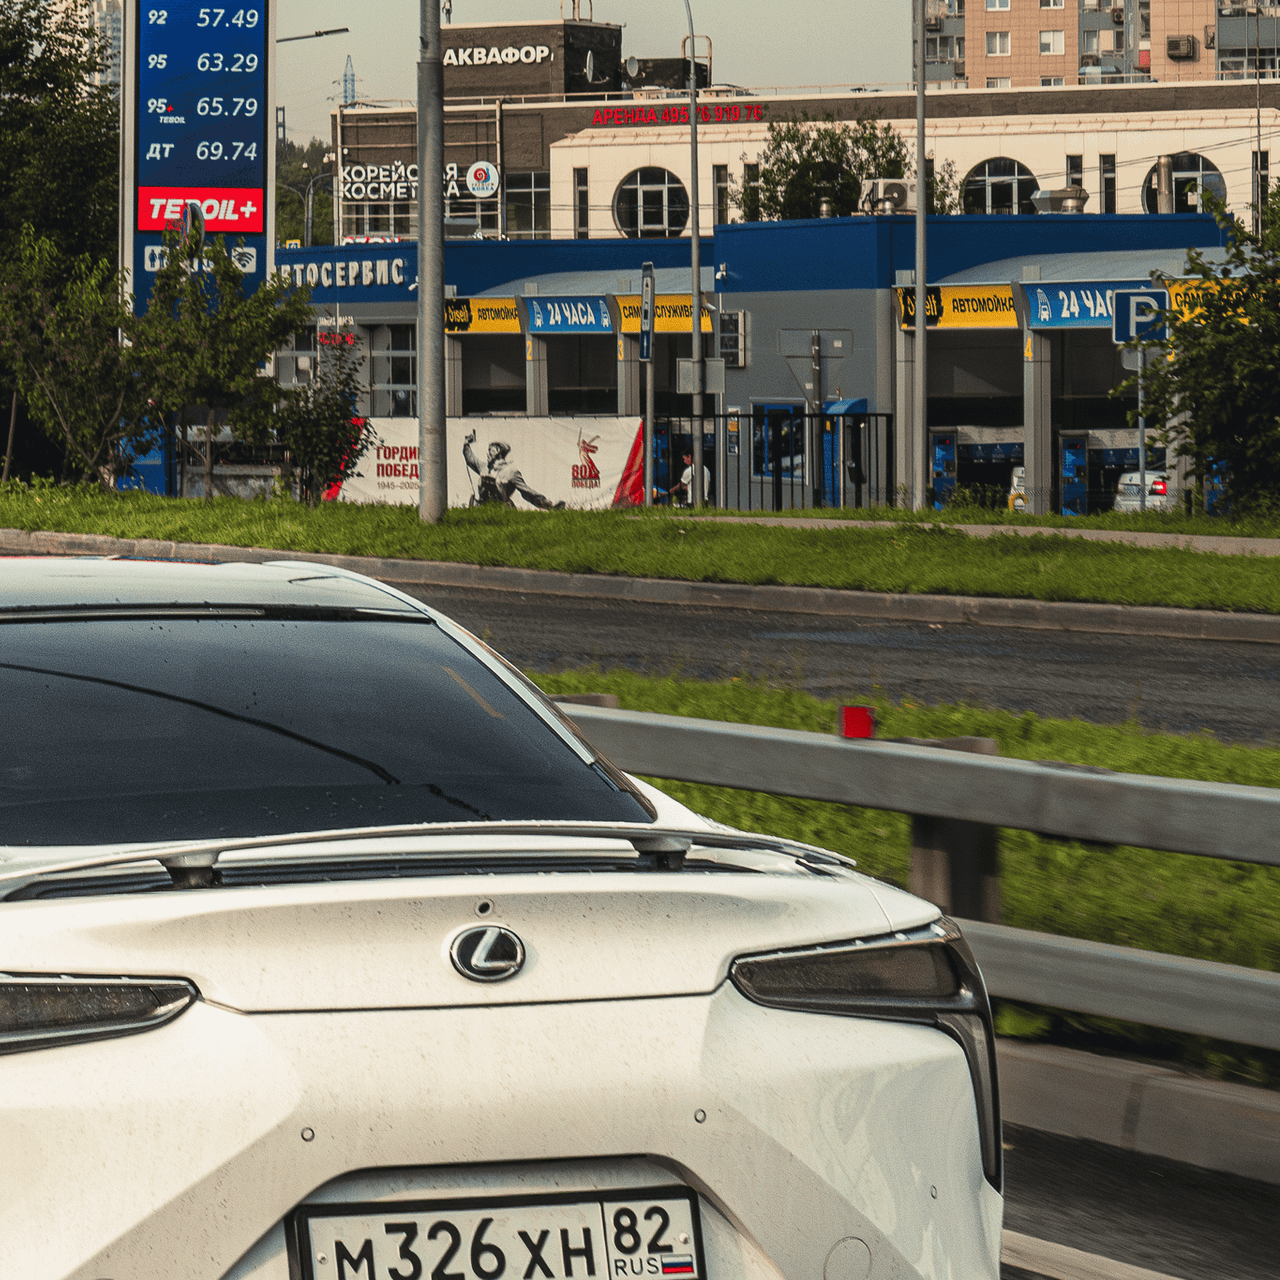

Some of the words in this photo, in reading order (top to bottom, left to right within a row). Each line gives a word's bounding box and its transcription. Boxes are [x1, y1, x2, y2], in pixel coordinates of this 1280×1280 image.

[148, 9, 168, 25] 92
[196, 8, 259, 28] 57.49
[148, 53, 168, 69] 95
[197, 52, 259, 72] 63.29
[443, 45, 549, 66] АКВАФОР
[147, 98, 167, 113] 95
[196, 97, 258, 117] 65.79
[592, 107, 657, 125] АРЕНДА
[661, 106, 689, 123] 495
[714, 105, 740, 121] 919
[744, 104, 762, 120] 76
[146, 142, 175, 160] ДТ
[196, 141, 257, 160] 69.74
[340, 160, 458, 183] КОРЕЙСЯ
[340, 180, 460, 200] КОСМЕТА
[274, 258, 404, 287] ВТОСЕРВИС
[477, 305, 518, 320] АВТОМОЙКА
[547, 302, 562, 325] 24
[561, 302, 596, 325] ЧАСА
[952, 294, 1015, 313] АВТОМОЙКА
[1058, 289, 1080, 318] 24
[1080, 289, 1113, 318] ЧАС
[1129, 296, 1159, 337] P
[377, 445, 420, 462] ГОРДИ
[377, 463, 420, 480] ПОБЕД
[613, 1206, 674, 1255] 82
[614, 1257, 660, 1277] RUS
